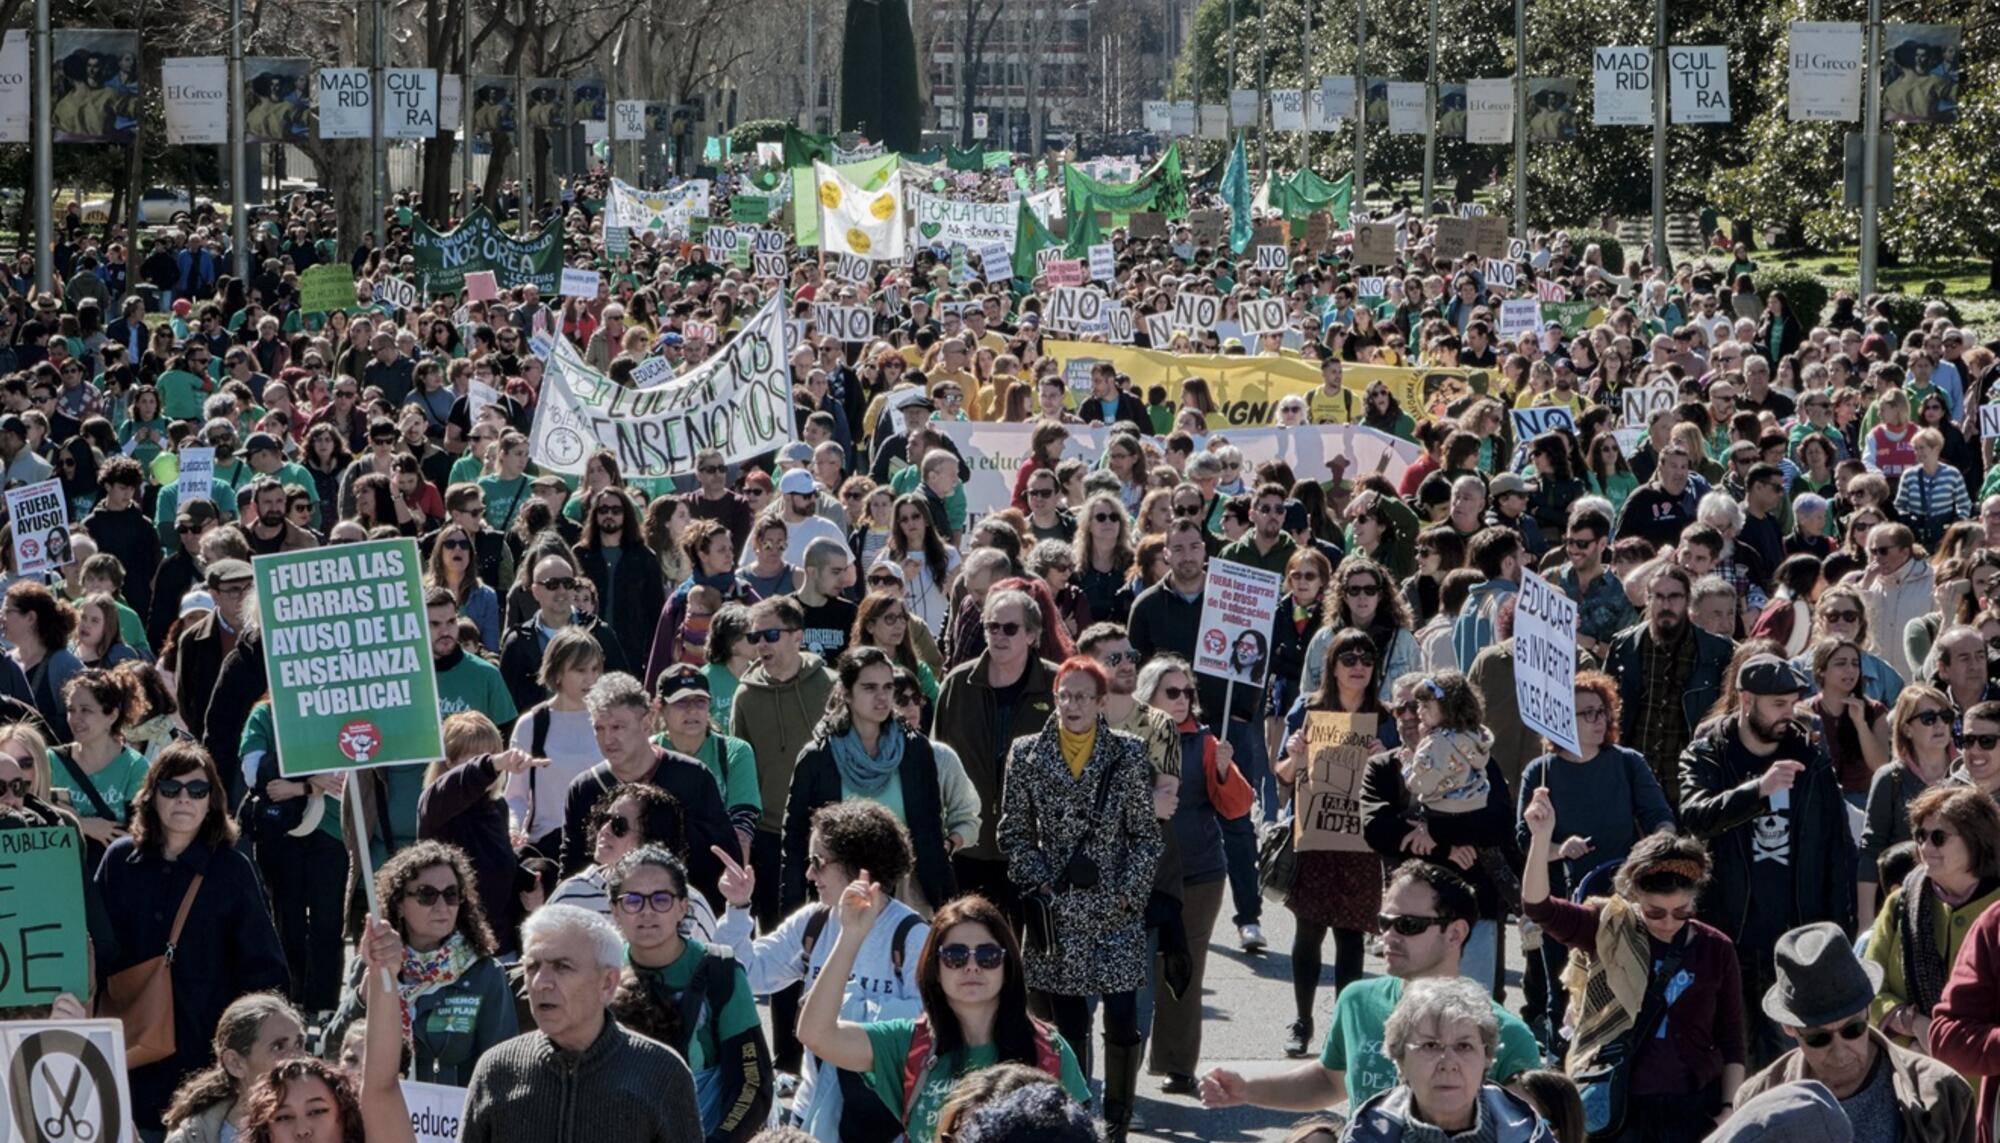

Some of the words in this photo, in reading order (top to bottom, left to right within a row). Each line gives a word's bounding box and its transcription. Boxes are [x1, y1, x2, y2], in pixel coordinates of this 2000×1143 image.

[1596, 53, 1650, 71] MAD
[1672, 52, 1717, 70] CUL
[1795, 54, 1808, 70] El
[1812, 54, 1857, 71] Greco
[321, 73, 369, 90] MAD
[387, 73, 426, 91] CUL
[1616, 72, 1650, 90] RID
[1680, 71, 1710, 89] TU
[168, 85, 180, 99] El
[183, 86, 222, 100] Greco
[338, 91, 369, 107] RID
[393, 91, 419, 108] TU
[1696, 90, 1726, 108] RA
[616, 104, 639, 114] CUL
[1470, 101, 1480, 111] El
[1482, 101, 1511, 111] Greco
[407, 109, 433, 126] RA
[622, 113, 635, 123] TU
[628, 122, 643, 132] RA
[952, 205, 971, 221] LA
[1463, 206, 1484, 217] NO
[413, 232, 427, 246] LA
[709, 229, 737, 249] NO
[757, 232, 783, 250] NO
[756, 256, 786, 278] NO
[840, 253, 869, 282] NO
[1259, 248, 1286, 268] NO
[1488, 262, 1515, 286] NO
[385, 275, 413, 307] NO
[1360, 279, 1384, 295] NO
[1539, 280, 1565, 302] NO
[1057, 288, 1100, 320] NO
[1177, 297, 1216, 326] NO
[828, 308, 870, 339] NO
[1108, 310, 1131, 340] NO
[1240, 301, 1285, 331] NO
[633, 360, 670, 385] EDUCAR
[1626, 389, 1675, 425] NO
[1514, 408, 1573, 439] NO
[15, 492, 60, 520] ¡FUERA
[17, 507, 64, 535] AYUSO!
[269, 556, 356, 595] ¡FUERA
[357, 549, 405, 580] LAS
[1209, 574, 1233, 588] FUERA
[1233, 580, 1247, 591] las
[1246, 584, 1275, 598] garras
[1221, 590, 1232, 600] de
[273, 584, 374, 623] GARRAS
[377, 581, 410, 610] DE
[1207, 597, 1219, 609] de
[1219, 600, 1228, 610] la
[1228, 602, 1271, 621] educación
[1518, 576, 1573, 641] EDUCAR
[1222, 613, 1252, 628] pública
[271, 620, 352, 656] AYUSO
[354, 616, 387, 646] DE
[390, 612, 422, 642] LA
[279, 646, 421, 688] ENSEÑANZA
[1516, 636, 1528, 665] es
[1530, 634, 1572, 692] INVERTIR
[297, 679, 412, 718] PÚBLICA!
[1530, 685, 1541, 721] ES
[1543, 691, 1576, 740] GASTAR
[2, 831, 72, 851] PUBLICA
[438, 1007, 451, 1016] UN
[453, 1007, 477, 1016] PLAN
[411, 1106, 459, 1138] educa
